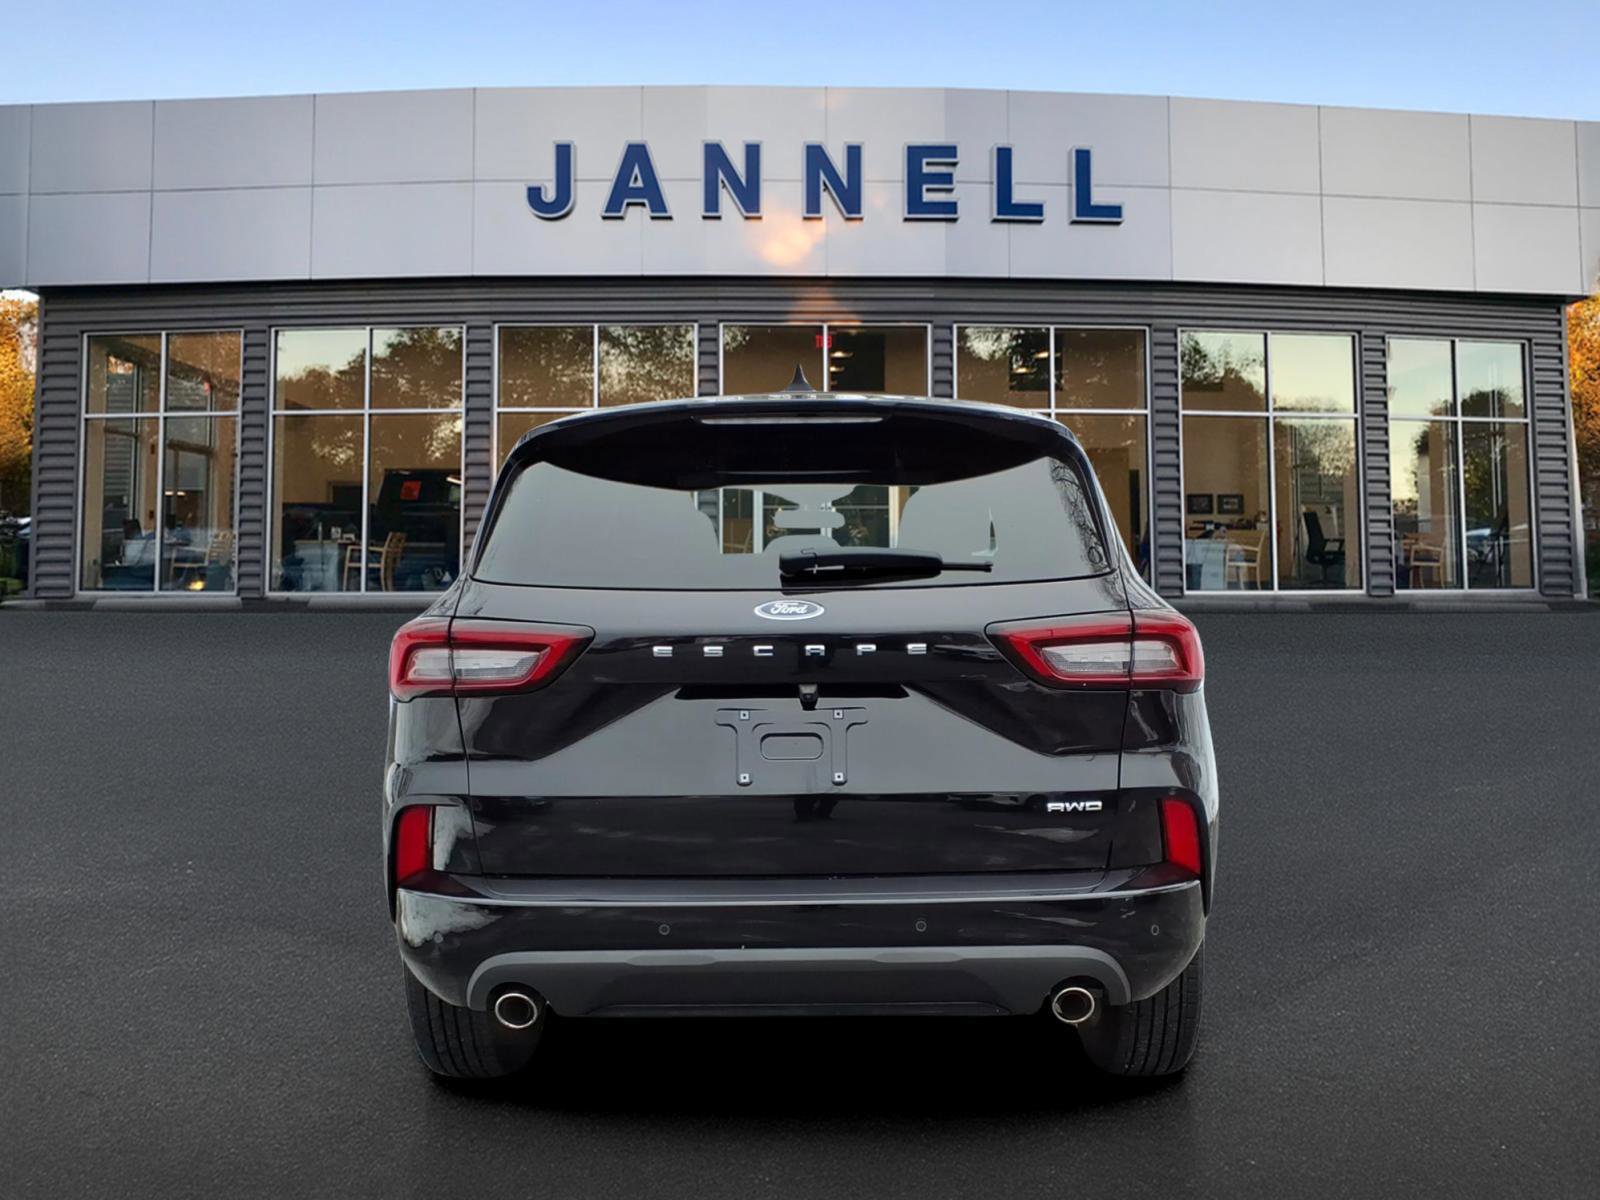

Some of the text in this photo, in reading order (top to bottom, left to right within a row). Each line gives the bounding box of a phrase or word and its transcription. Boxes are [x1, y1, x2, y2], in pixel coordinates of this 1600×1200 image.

[526, 140, 1123, 221] JANNELL
[770, 602, 809, 615] Ford
[652, 643, 928, 658] ESCAPE
[1046, 801, 1103, 812] AWD
